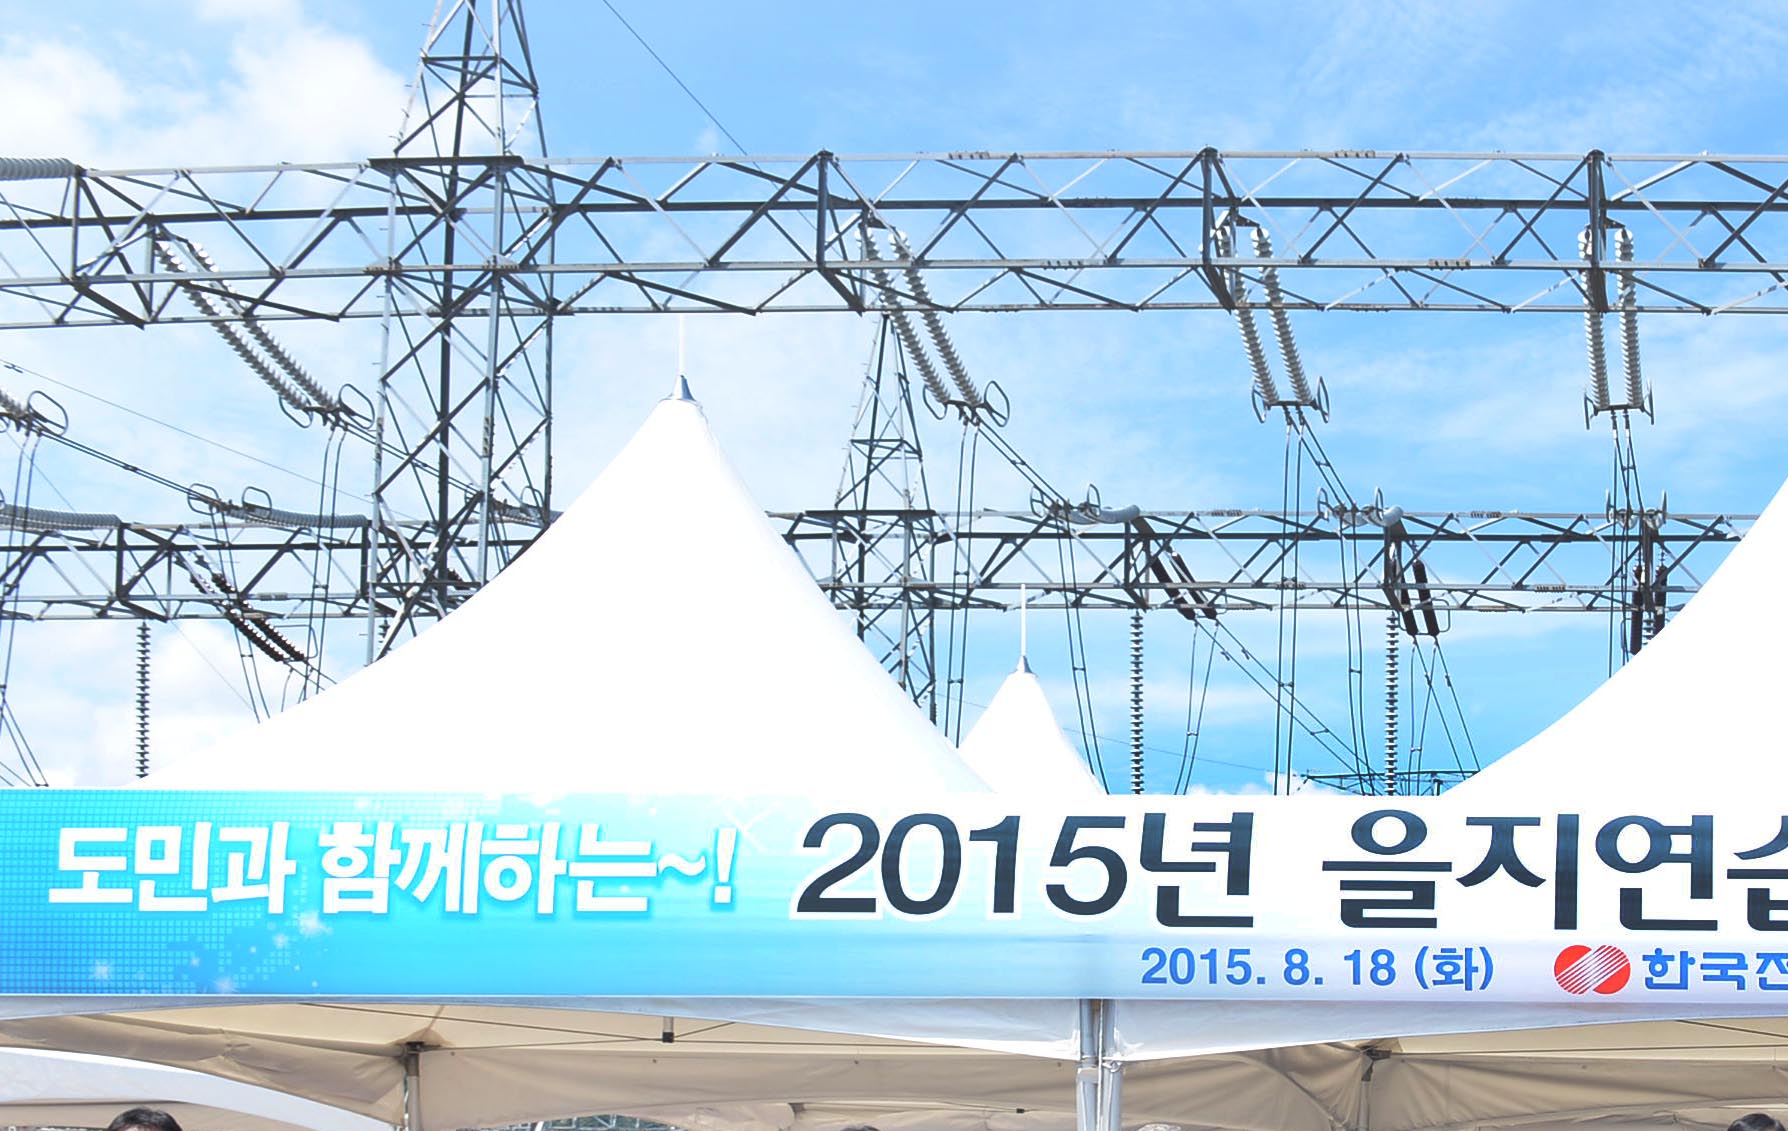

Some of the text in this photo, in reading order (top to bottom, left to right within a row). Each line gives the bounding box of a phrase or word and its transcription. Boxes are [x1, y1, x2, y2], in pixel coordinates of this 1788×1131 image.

[48, 820, 296, 914] 도민과
[319, 820, 738, 915] 함께하는~!
[797, 811, 1254, 928] 2015년
[1140, 946, 1495, 993] 2015. 8. 18 (화)
